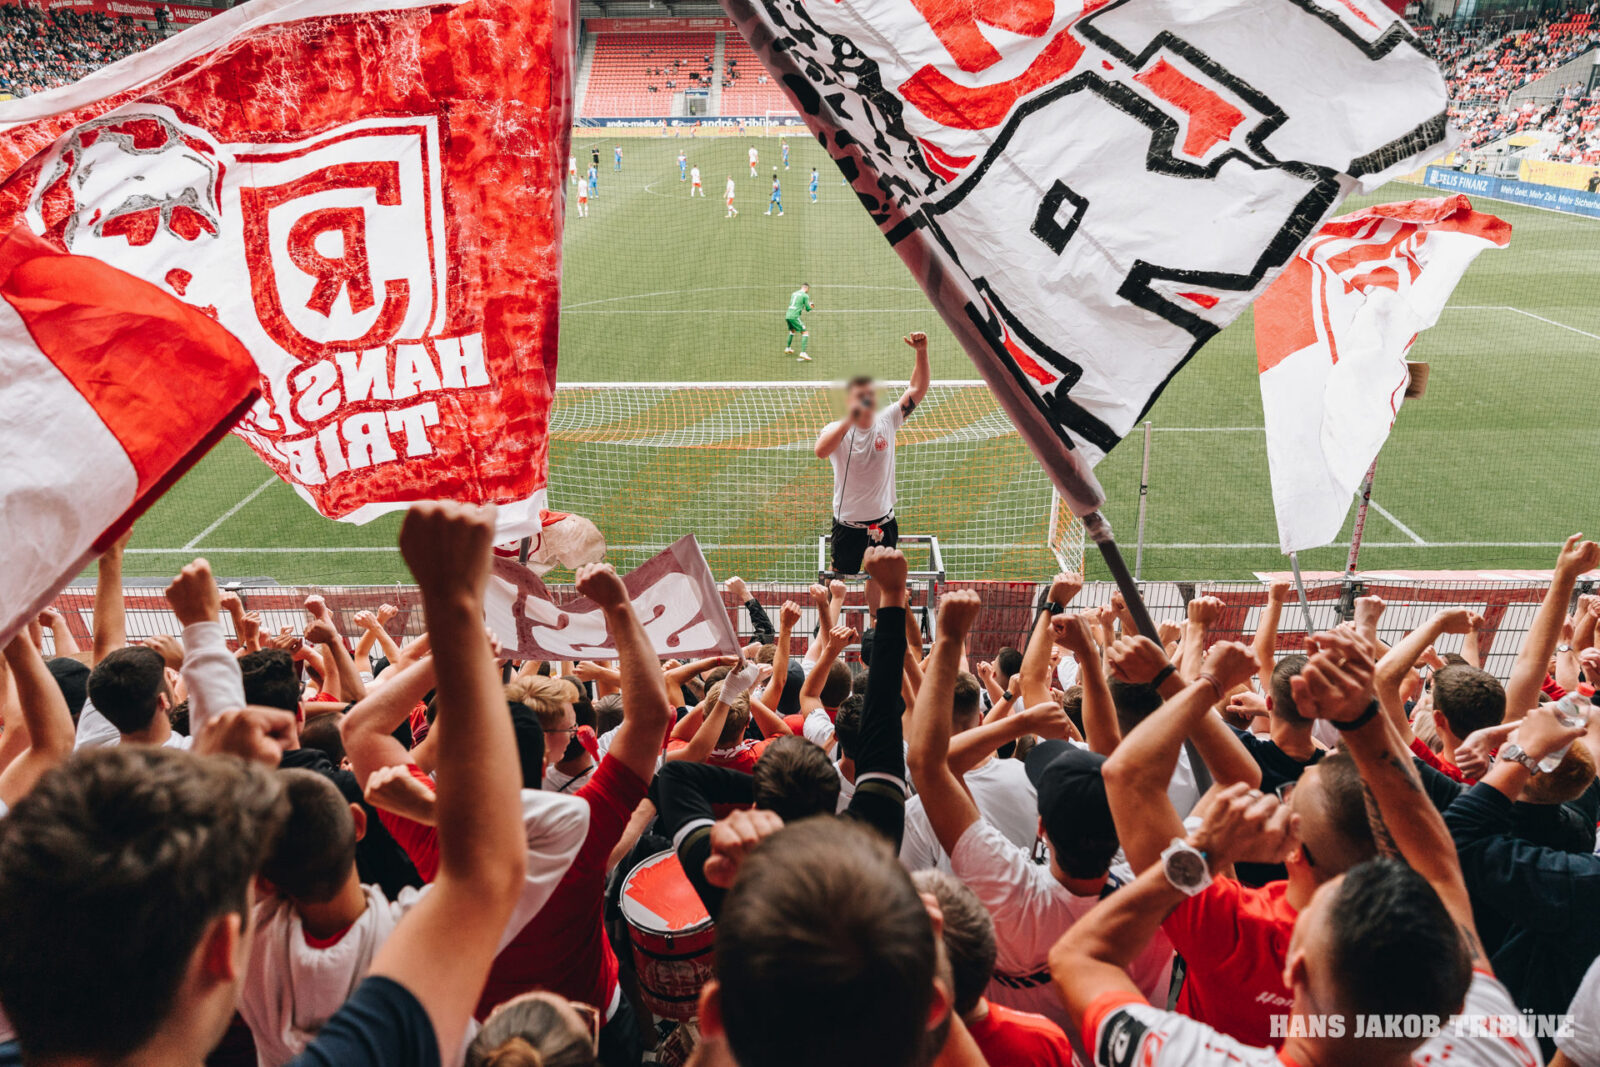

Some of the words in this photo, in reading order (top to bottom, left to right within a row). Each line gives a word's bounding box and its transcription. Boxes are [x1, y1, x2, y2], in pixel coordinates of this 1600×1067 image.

[1458, 176, 1488, 192] FINANZ
[1501, 185, 1514, 194] Mehr
[1529, 190, 1544, 199] Mehr
[1558, 194, 1573, 205] Mehr
